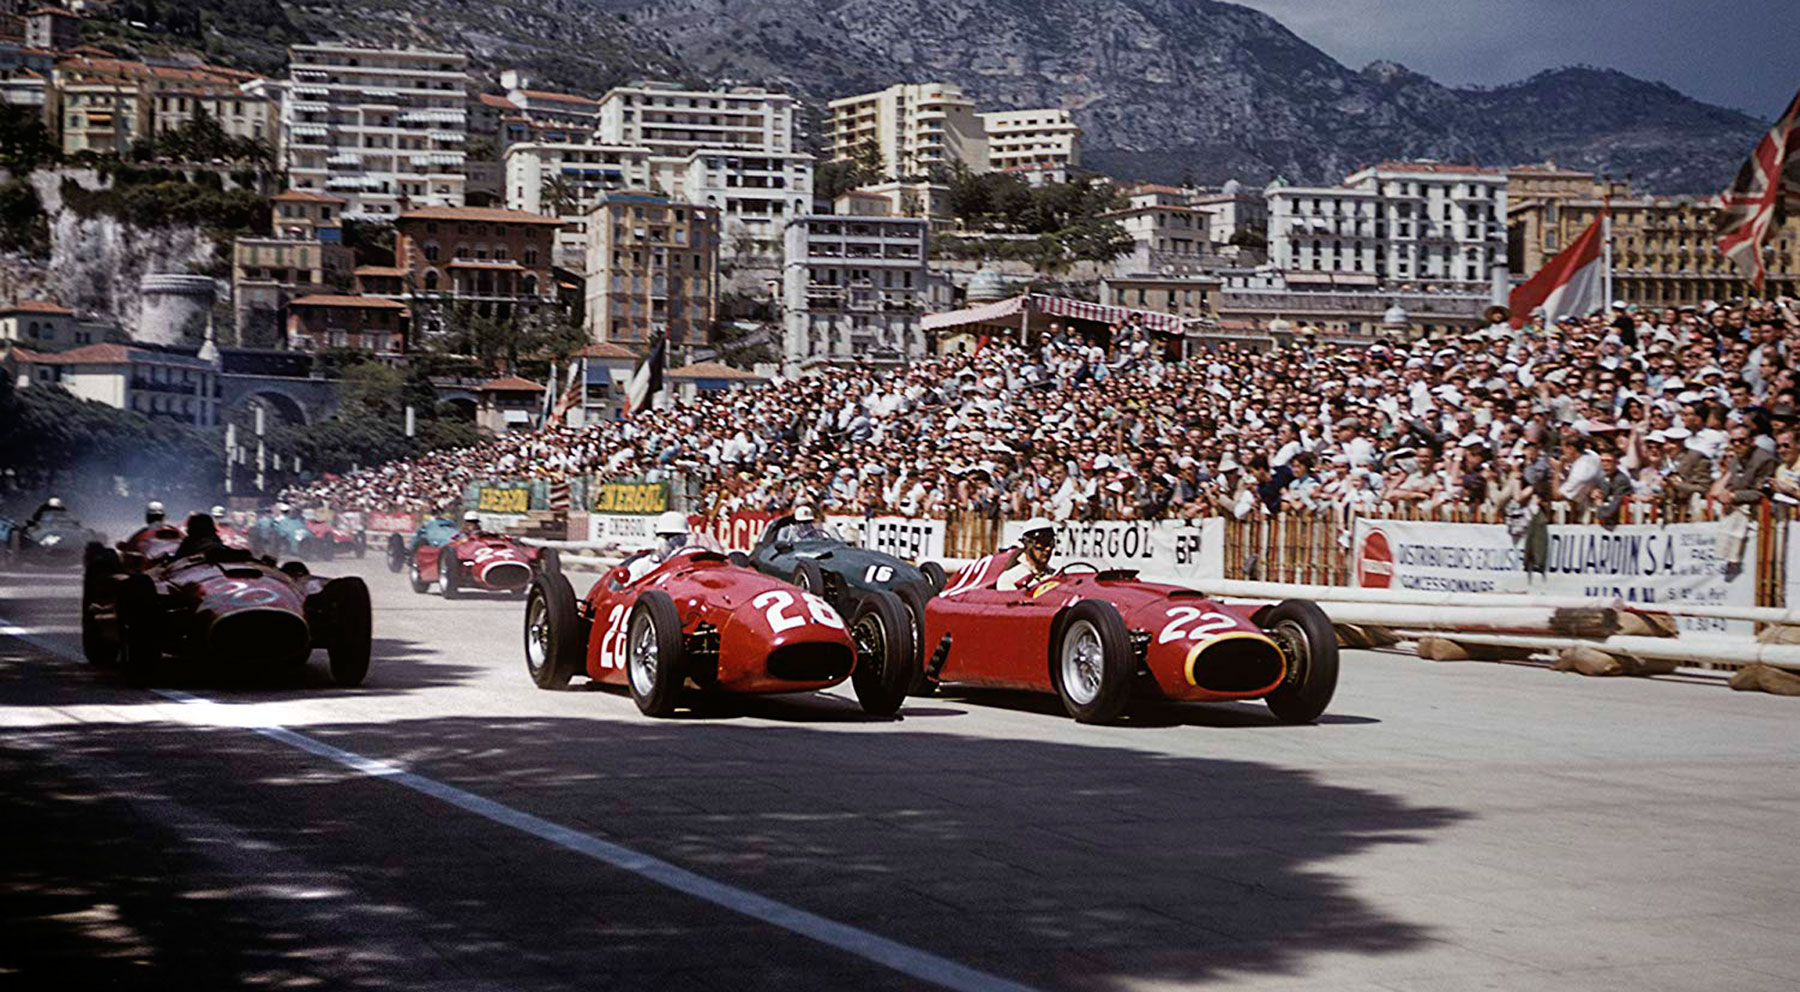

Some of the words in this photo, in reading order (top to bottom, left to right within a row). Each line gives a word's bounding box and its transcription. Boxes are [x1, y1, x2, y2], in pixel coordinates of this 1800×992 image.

[1053, 525, 1152, 559] ENERGOL
[1175, 534, 1201, 565] BP
[1549, 533, 1641, 576] DUJARDIN
[863, 563, 894, 584] 16
[938, 553, 994, 598] 22
[752, 589, 846, 634] 28
[1158, 605, 1237, 645] 22
